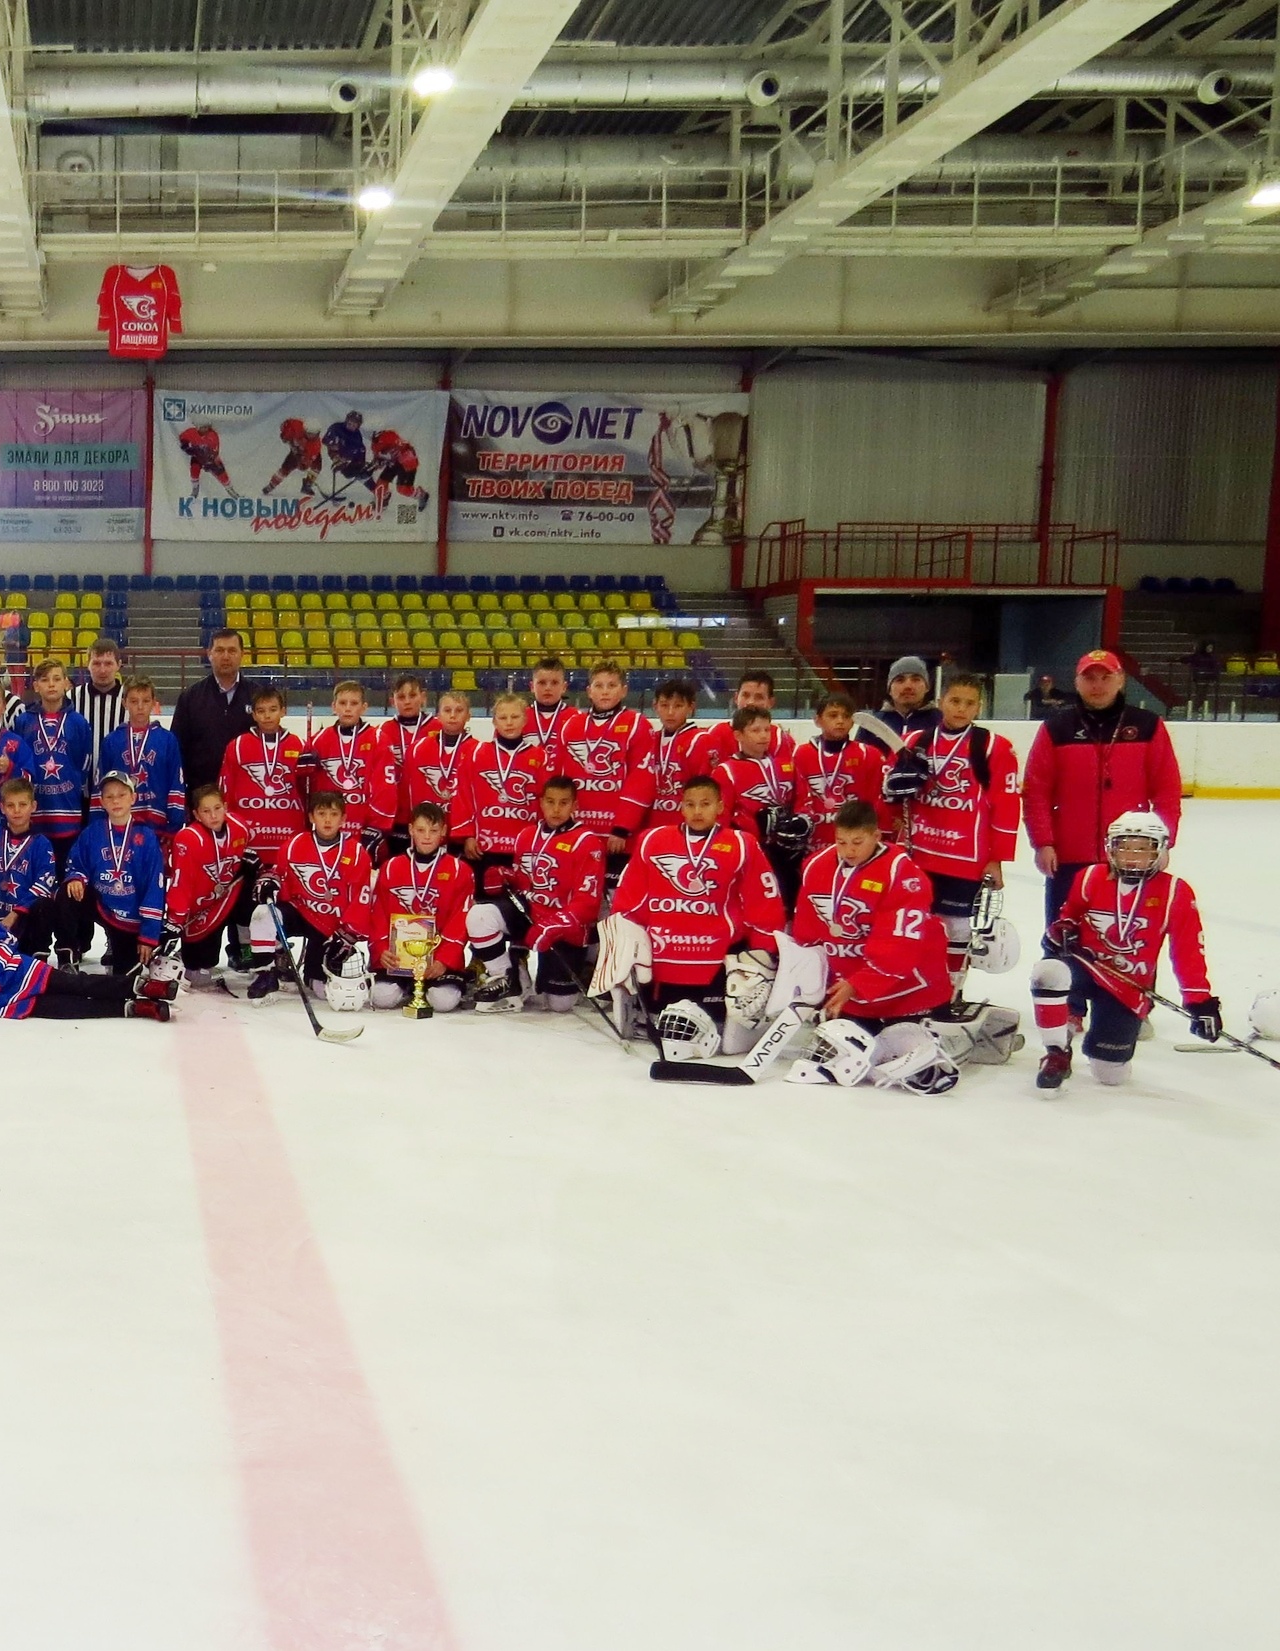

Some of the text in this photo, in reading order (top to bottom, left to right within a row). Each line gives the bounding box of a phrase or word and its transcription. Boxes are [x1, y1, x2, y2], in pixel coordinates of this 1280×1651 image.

[122, 322, 159, 333] СОКОЛ
[190, 404, 253, 416] ХИМПРОМ
[7, 449, 130, 466] ЭМАЛИ ДЛЯ ДЕКОРА
[476, 451, 626, 473] ТЕРРИТОРИЯ
[33, 480, 40, 492] 8
[42, 480, 60, 492] 800
[63, 480, 79, 492] 100
[466, 478, 635, 504] ТВОИХ ПОБЕД
[178, 497, 301, 518] К НОВЫМ
[250, 485, 385, 540] победам!
[578, 511, 635, 523] 76-00-00
[238, 797, 300, 810] СОКОЛ
[648, 897, 719, 917] СОКОЛ
[892, 908, 924, 940] 12
[745, 1021, 795, 1069] VAPOR
